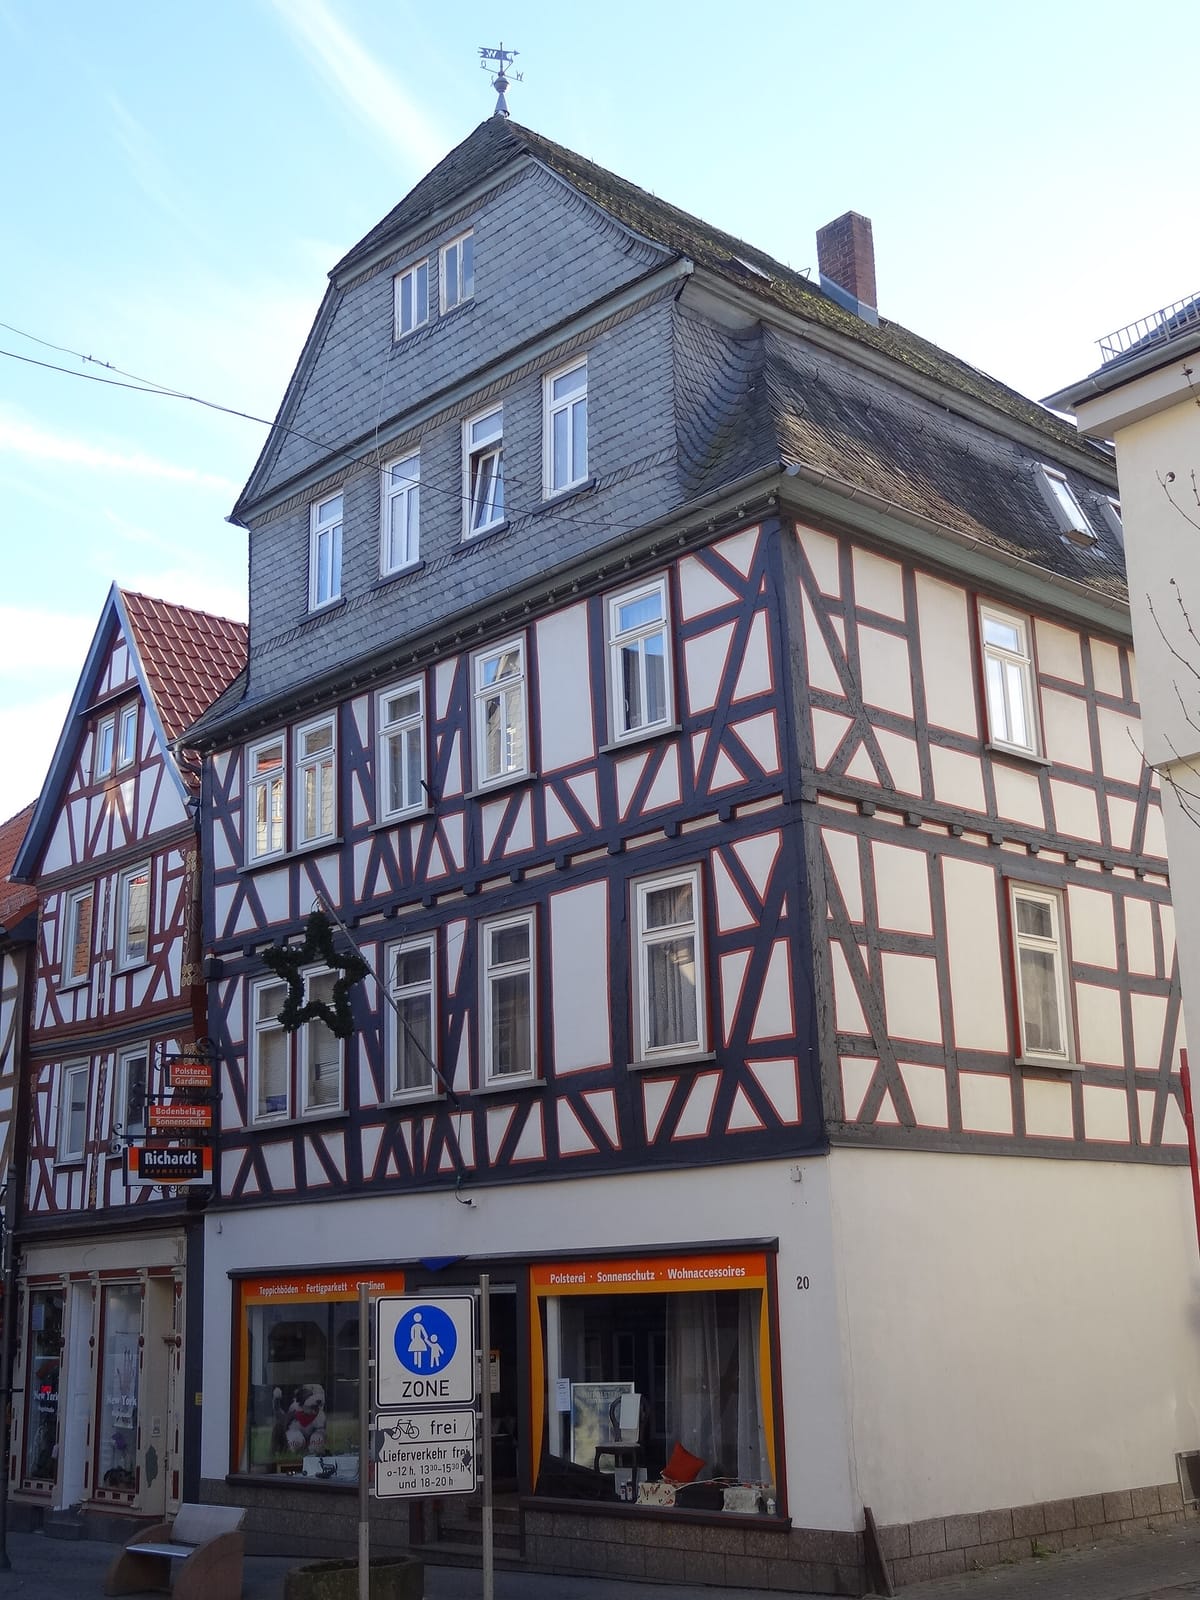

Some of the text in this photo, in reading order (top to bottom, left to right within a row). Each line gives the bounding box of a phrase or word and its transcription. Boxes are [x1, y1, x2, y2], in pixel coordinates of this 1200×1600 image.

[175, 1067, 208, 1075] Polsterei
[175, 1077, 208, 1085] Gardinen
[155, 1107, 206, 1116] Bodenbeläge
[155, 1117, 206, 1126] Sonnenschutz
[144, 1150, 198, 1165] Richardt
[550, 1265, 746, 1284] Polsterei Sonnenschutz Wohnaccessoires
[259, 1280, 385, 1296] Teppichböden Fertigparkett Gdinen
[796, 1275, 810, 1290] 20
[402, 1380, 450, 1397] ZONE
[121, 1394, 137, 1406] York
[430, 1419, 457, 1435] frei
[383, 1445, 469, 1463] Lieferverkehr frei
[398, 1479, 417, 1489] und
[420, 1478, 447, 1488] 18-20
